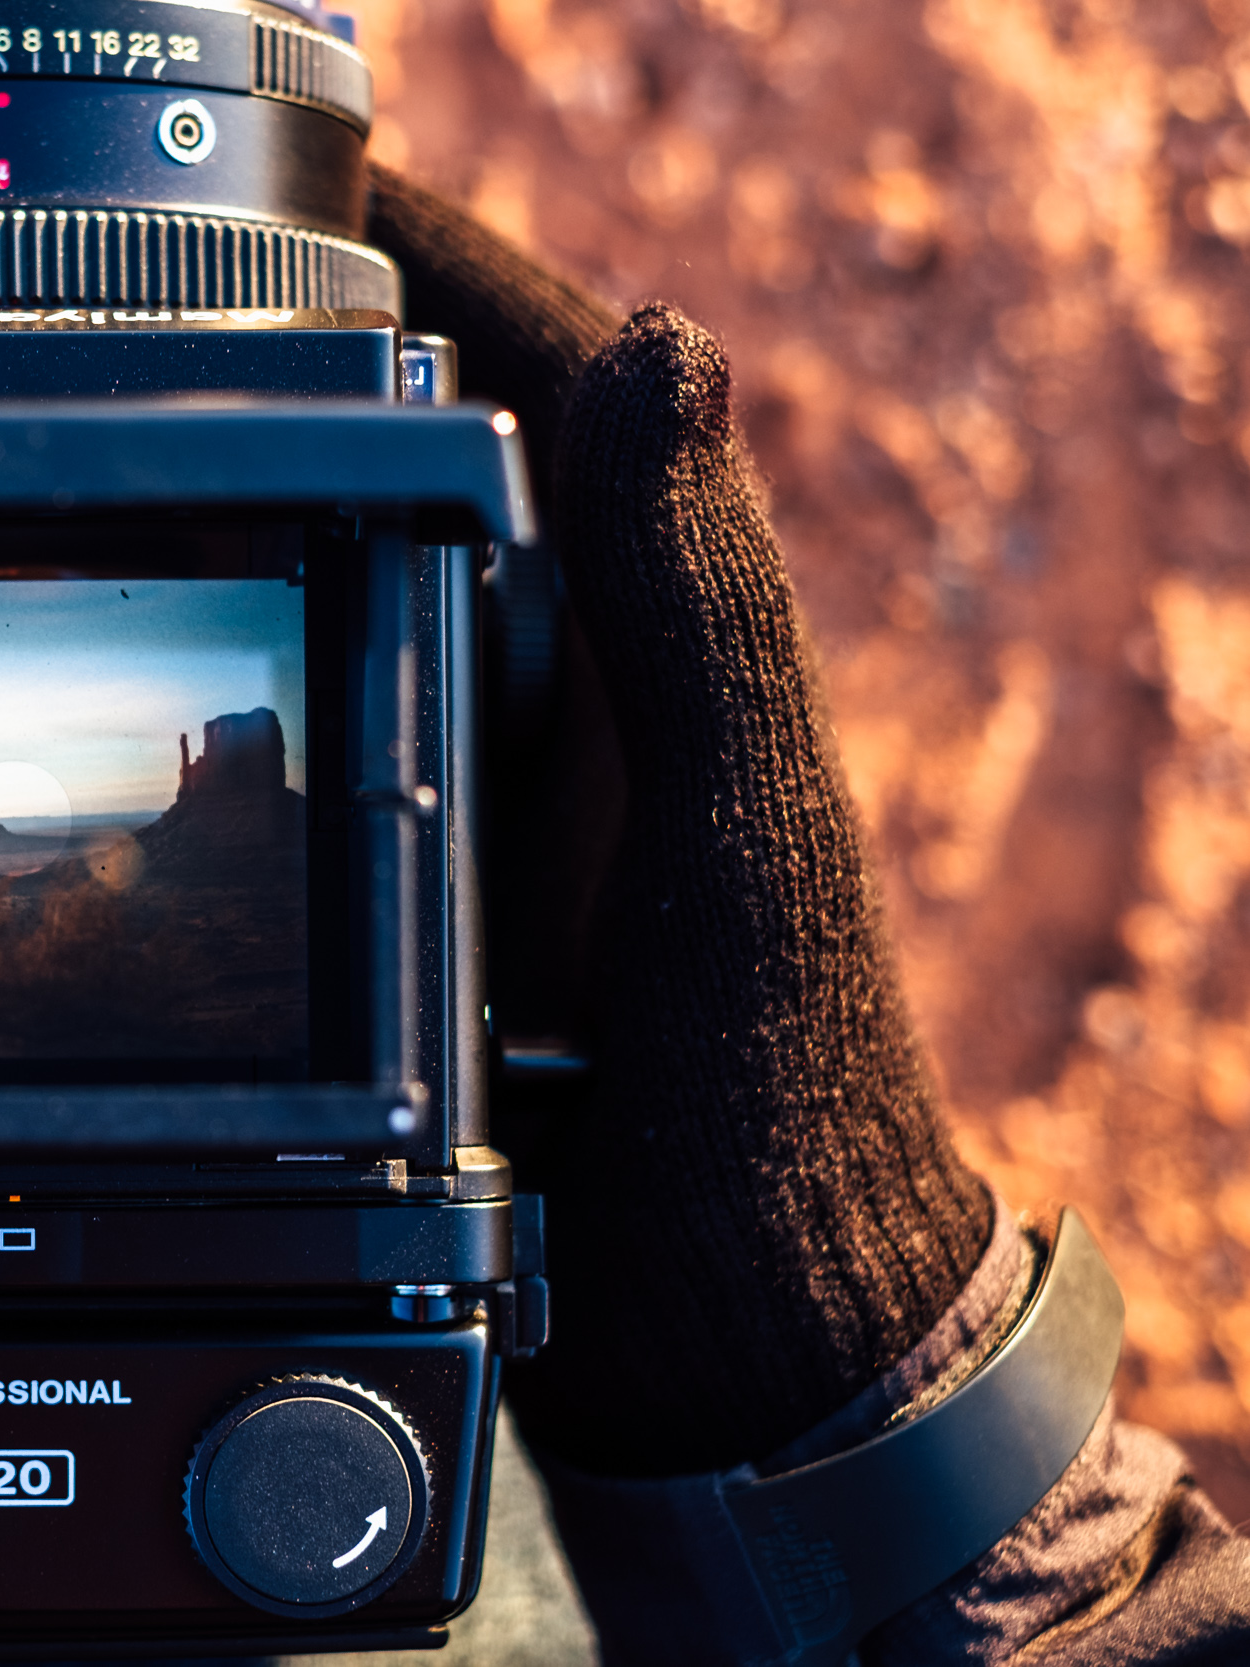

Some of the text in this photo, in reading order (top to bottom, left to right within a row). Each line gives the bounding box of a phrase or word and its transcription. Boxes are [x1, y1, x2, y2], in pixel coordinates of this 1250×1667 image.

[22, 28, 42, 52] 8
[53, 30, 82, 53] 11
[90, 30, 121, 55] 16
[128, 32, 161, 58] 22
[167, 35, 200, 62] 32
[0, 310, 295, 324] Mamiya
